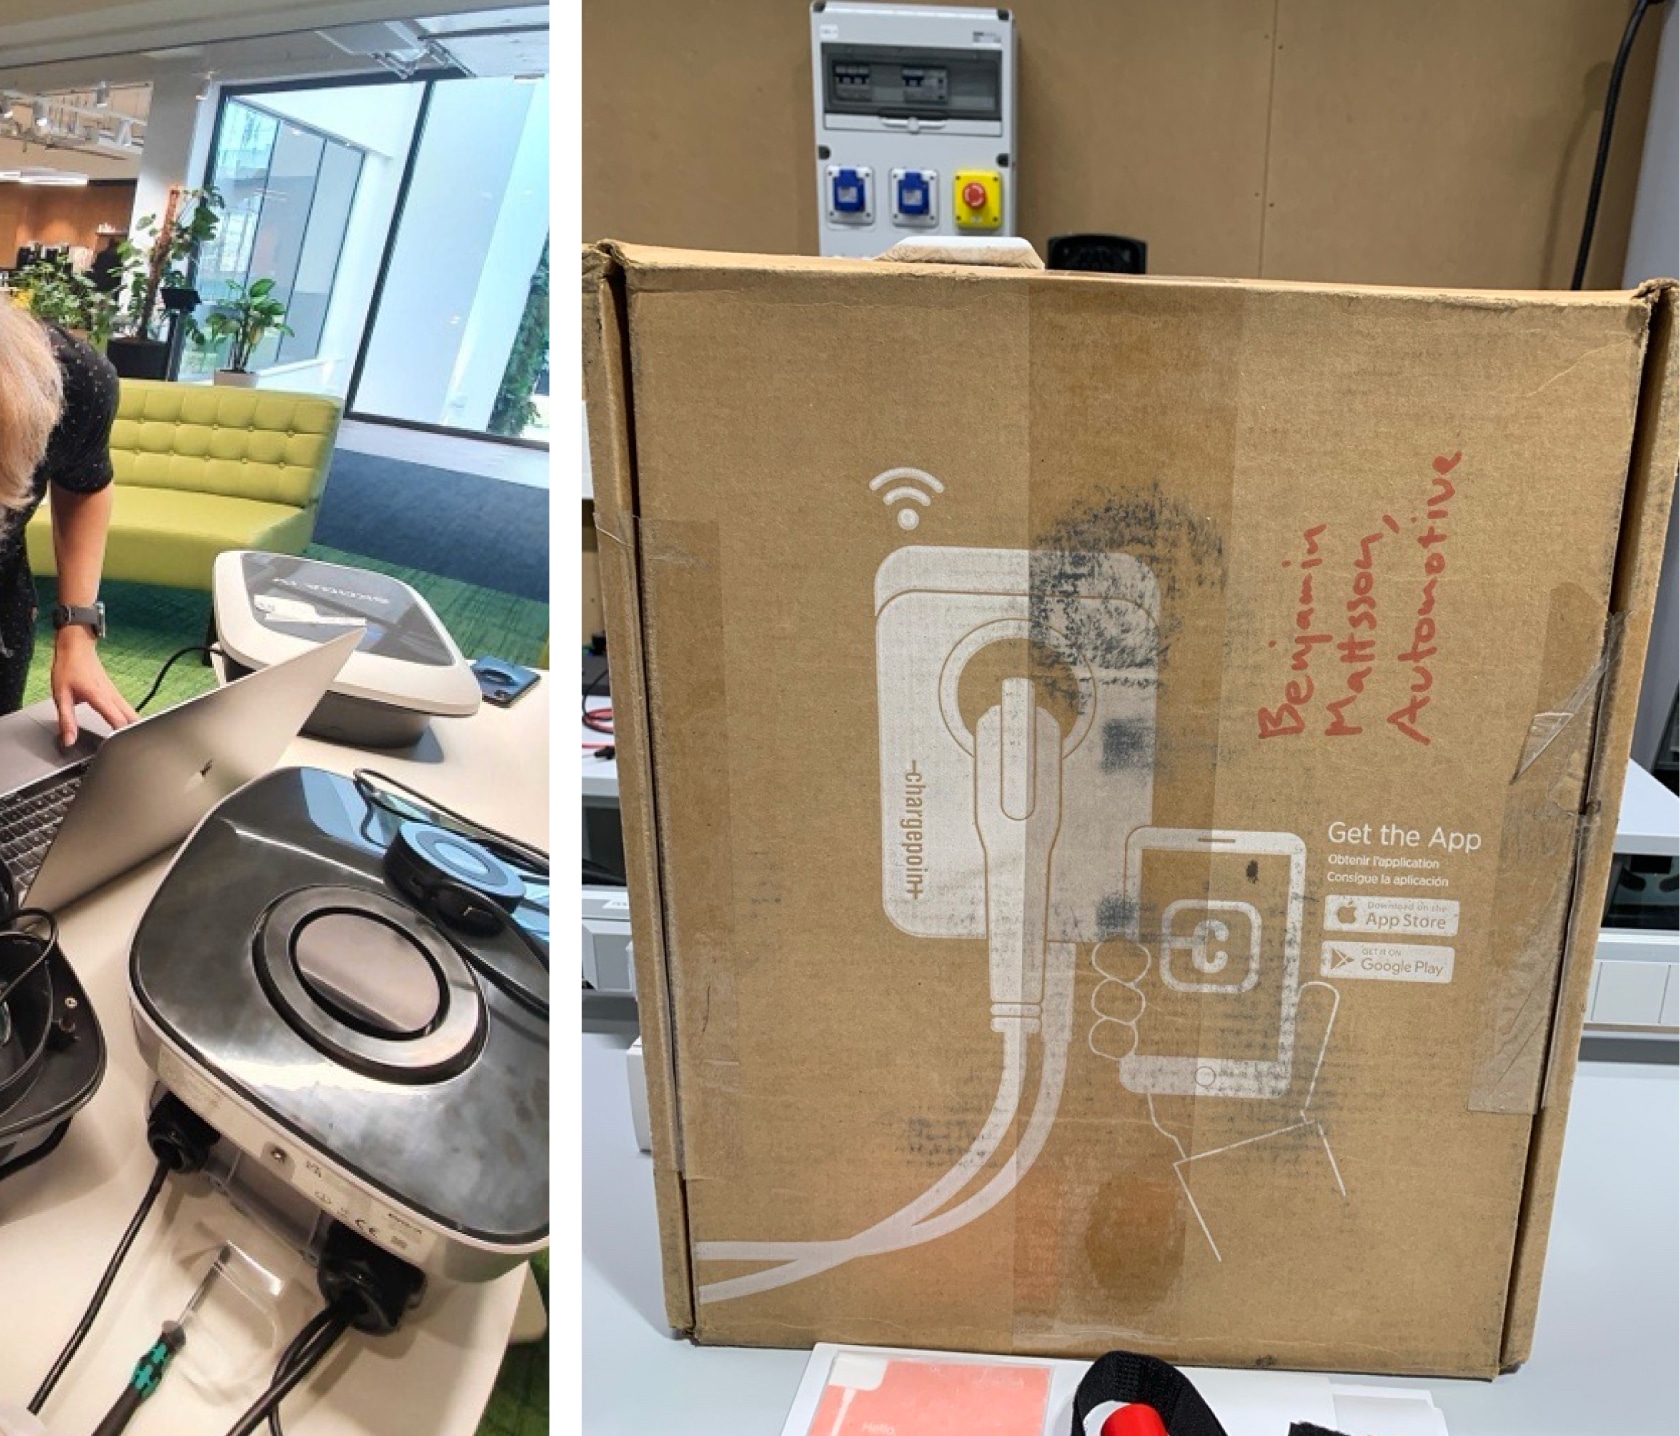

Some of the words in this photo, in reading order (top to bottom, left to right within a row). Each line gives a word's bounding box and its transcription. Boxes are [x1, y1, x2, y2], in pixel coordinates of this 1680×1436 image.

[1386, 451, 1462, 746] Automotive
[1258, 524, 1333, 739] Benjamin
[1328, 821, 1372, 845] Get
[1380, 823, 1420, 847] the
[1428, 826, 1482, 854] App
[1328, 854, 1371, 866] Obtenir
[1373, 855, 1440, 869] l'application
[1327, 872, 1378, 885] Consigue
[1381, 873, 1391, 884] la
[1393, 874, 1449, 887] aplicación
[1367, 901, 1414, 911] Download
[1416, 903, 1429, 911] on
[1431, 903, 1448, 913] the
[1365, 912, 1400, 930] App
[1403, 913, 1446, 930] Store
[1362, 947, 1378, 956] GET
[1379, 948, 1387, 956] IT
[1388, 949, 1401, 957] ON
[1360, 958, 1412, 975] Google
[1414, 961, 1445, 978] Play
